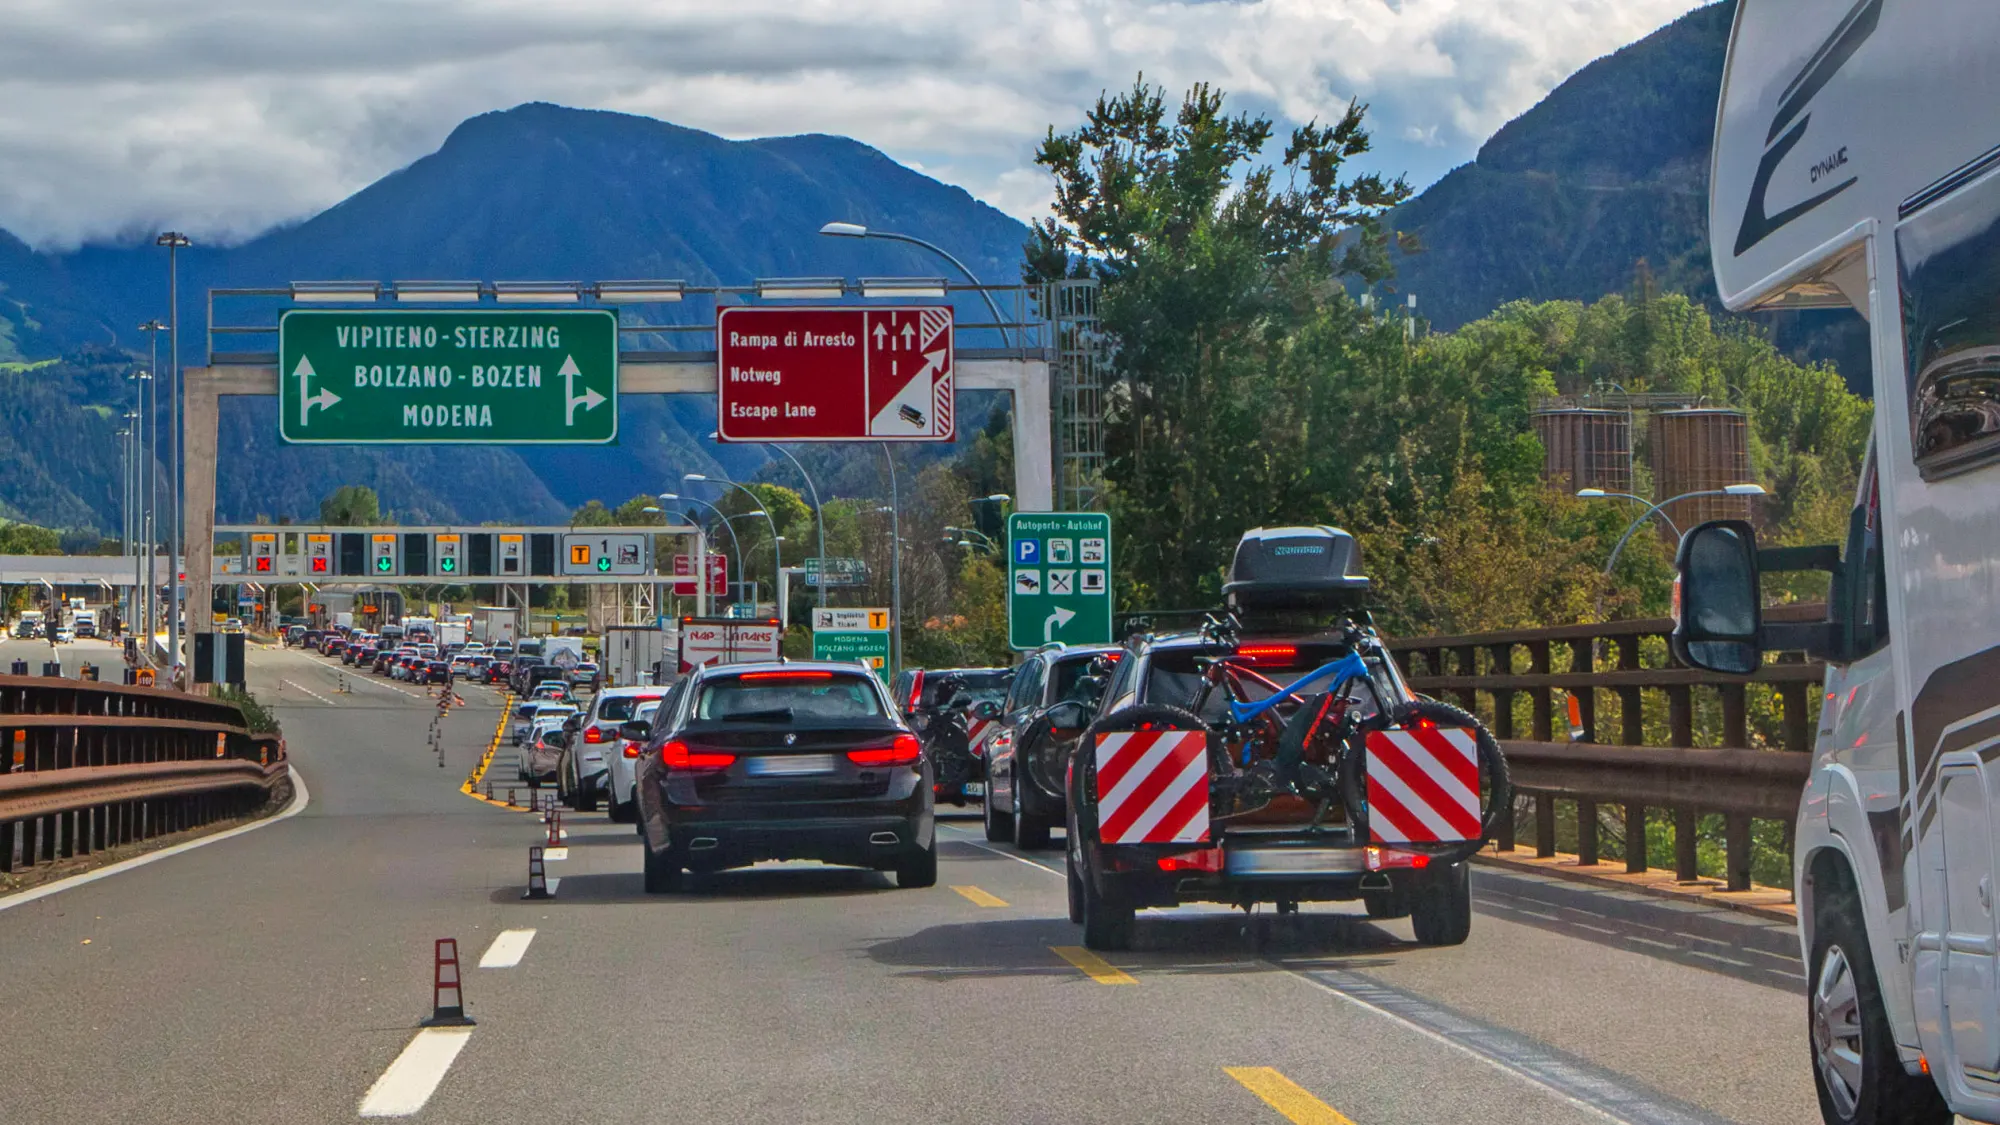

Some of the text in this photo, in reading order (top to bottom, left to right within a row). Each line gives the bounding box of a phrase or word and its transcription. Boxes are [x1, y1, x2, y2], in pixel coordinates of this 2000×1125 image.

[730, 331, 856, 350] Rampa di Arresto
[730, 366, 781, 386] Notweg
[402, 403, 494, 427] MODENA
[730, 401, 817, 421] Escape Lane
[601, 539, 608, 554] 1
[834, 635, 869, 643] MODENA
